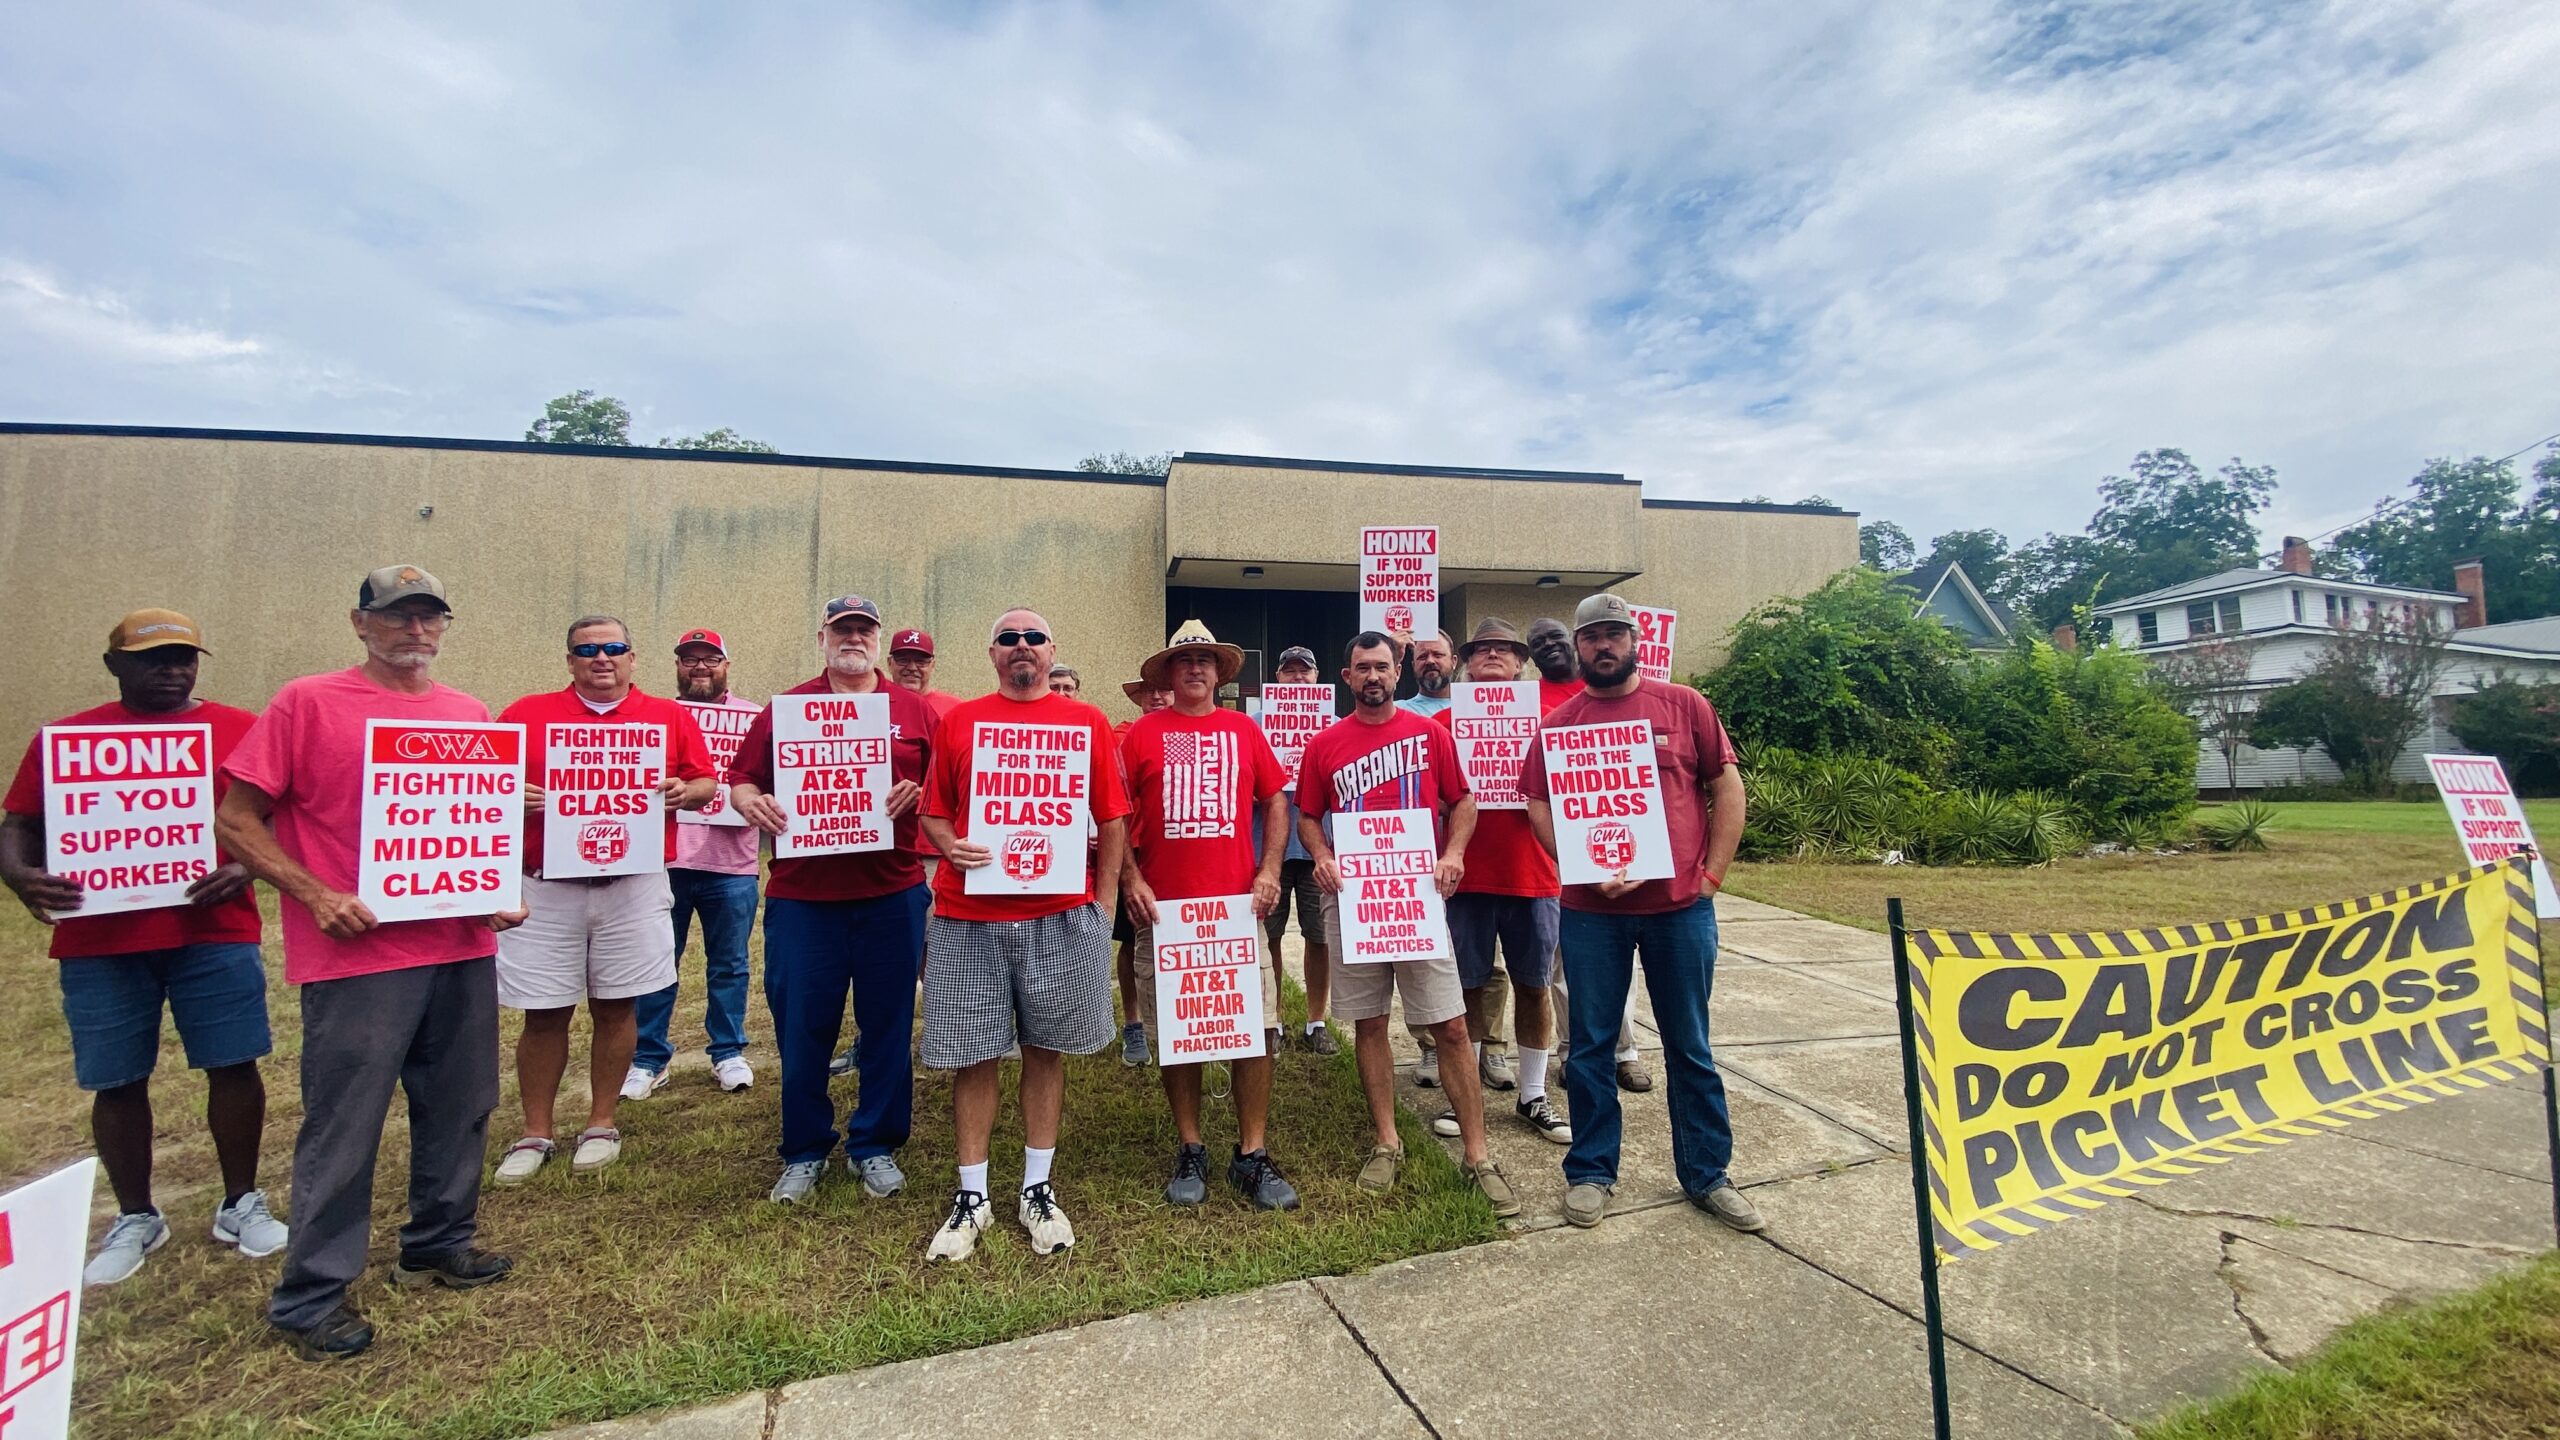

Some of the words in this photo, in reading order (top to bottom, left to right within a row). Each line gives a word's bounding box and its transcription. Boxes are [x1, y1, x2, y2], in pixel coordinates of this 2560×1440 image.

[1367, 532, 1432, 553] HONK
[1377, 558, 1389, 571] IF
[1394, 558, 1422, 571] YOU
[1366, 574, 1432, 587] SUPPORT
[1364, 590, 1434, 602] WORKERS
[1389, 609, 1408, 617] CWA
[1636, 667, 1669, 680] TRIKE!!
[1265, 687, 1332, 700] FIGHTING
[1474, 688, 1515, 703] CWA
[805, 701, 858, 721] CWA
[1277, 703, 1297, 712] FOR
[1300, 703, 1319, 712] THE
[1487, 705, 1504, 715] ON
[822, 724, 843, 737] ON
[1265, 714, 1331, 730] MIDDLE
[1456, 719, 1537, 738] STRIKE!
[395, 732, 499, 760] CWA
[550, 728, 660, 747] FIGHTING
[978, 728, 1086, 752] FIGHTING
[1270, 732, 1312, 748] CLAS
[1545, 725, 1648, 752] FIGHTING
[57, 737, 199, 777] HONK
[570, 752, 605, 764] FOR
[609, 751, 640, 764] THE
[781, 740, 885, 767] STRIKE!
[1472, 741, 1523, 758] AT&T
[1566, 753, 1597, 768] FOR
[1601, 750, 1632, 764] THE
[997, 753, 1030, 768] FOR
[1035, 755, 1066, 770] THE
[1332, 733, 1430, 809] ORGANIZE
[1468, 760, 1524, 777] UNFAIR
[373, 773, 516, 795] FIGHTING
[549, 768, 659, 791] MIDDLE
[802, 768, 867, 791] AT&T
[976, 772, 1084, 798] MIDDLE
[1201, 731, 1218, 819] TRUMP
[1479, 779, 1518, 790] LABOR
[1551, 765, 1655, 795] MIDDLE
[2434, 763, 2504, 792] HONK
[65, 792, 100, 815] IF
[116, 787, 196, 812] YOU
[558, 793, 649, 816] CLASS
[796, 792, 872, 816] UNFAIR
[1474, 791, 1528, 803] RACTICE
[1564, 793, 1648, 820] CLASS
[2461, 798, 2476, 816] IF
[2479, 798, 2507, 816] YOU
[386, 803, 436, 826] for
[449, 802, 503, 824] the
[984, 801, 1072, 826] CLASS
[586, 826, 621, 839] CWA
[810, 816, 861, 832] LABOR
[1164, 821, 1235, 839] 2024
[1359, 816, 1405, 836] CWA
[1593, 826, 1626, 842] CWA
[2461, 820, 2525, 839] SUPPORT
[60, 823, 204, 855] SUPPORT
[374, 835, 511, 862] MIDDLE
[793, 830, 879, 849] PRACTICES
[1010, 838, 1046, 852] CWA
[1375, 837, 1394, 850] ON
[1341, 851, 1434, 878] STRIKE!
[383, 869, 500, 898] CLASS
[1361, 878, 1417, 900] AT&T
[1180, 901, 1229, 924] CWA
[1357, 901, 1426, 924] UNFAIR
[1196, 924, 1217, 939] ON
[1370, 924, 1417, 939] LABOR
[1160, 939, 1255, 970] STRIKE!
[1356, 938, 1434, 955] PRACTICES
[1958, 886, 2474, 1051] CAUTION
[1180, 969, 1238, 994] AT&T
[1175, 993, 1245, 1020] UNFAIR
[1188, 1019, 1235, 1036] LABOR
[1173, 1034, 1251, 1054] PRACTICES
[1954, 1062, 2069, 1122] DO
[2089, 1018, 2225, 1098] NOT
[2243, 958, 2480, 1050] CROSS
[1963, 1064, 2279, 1209] PICKET
[2293, 1007, 2501, 1105] LINE
